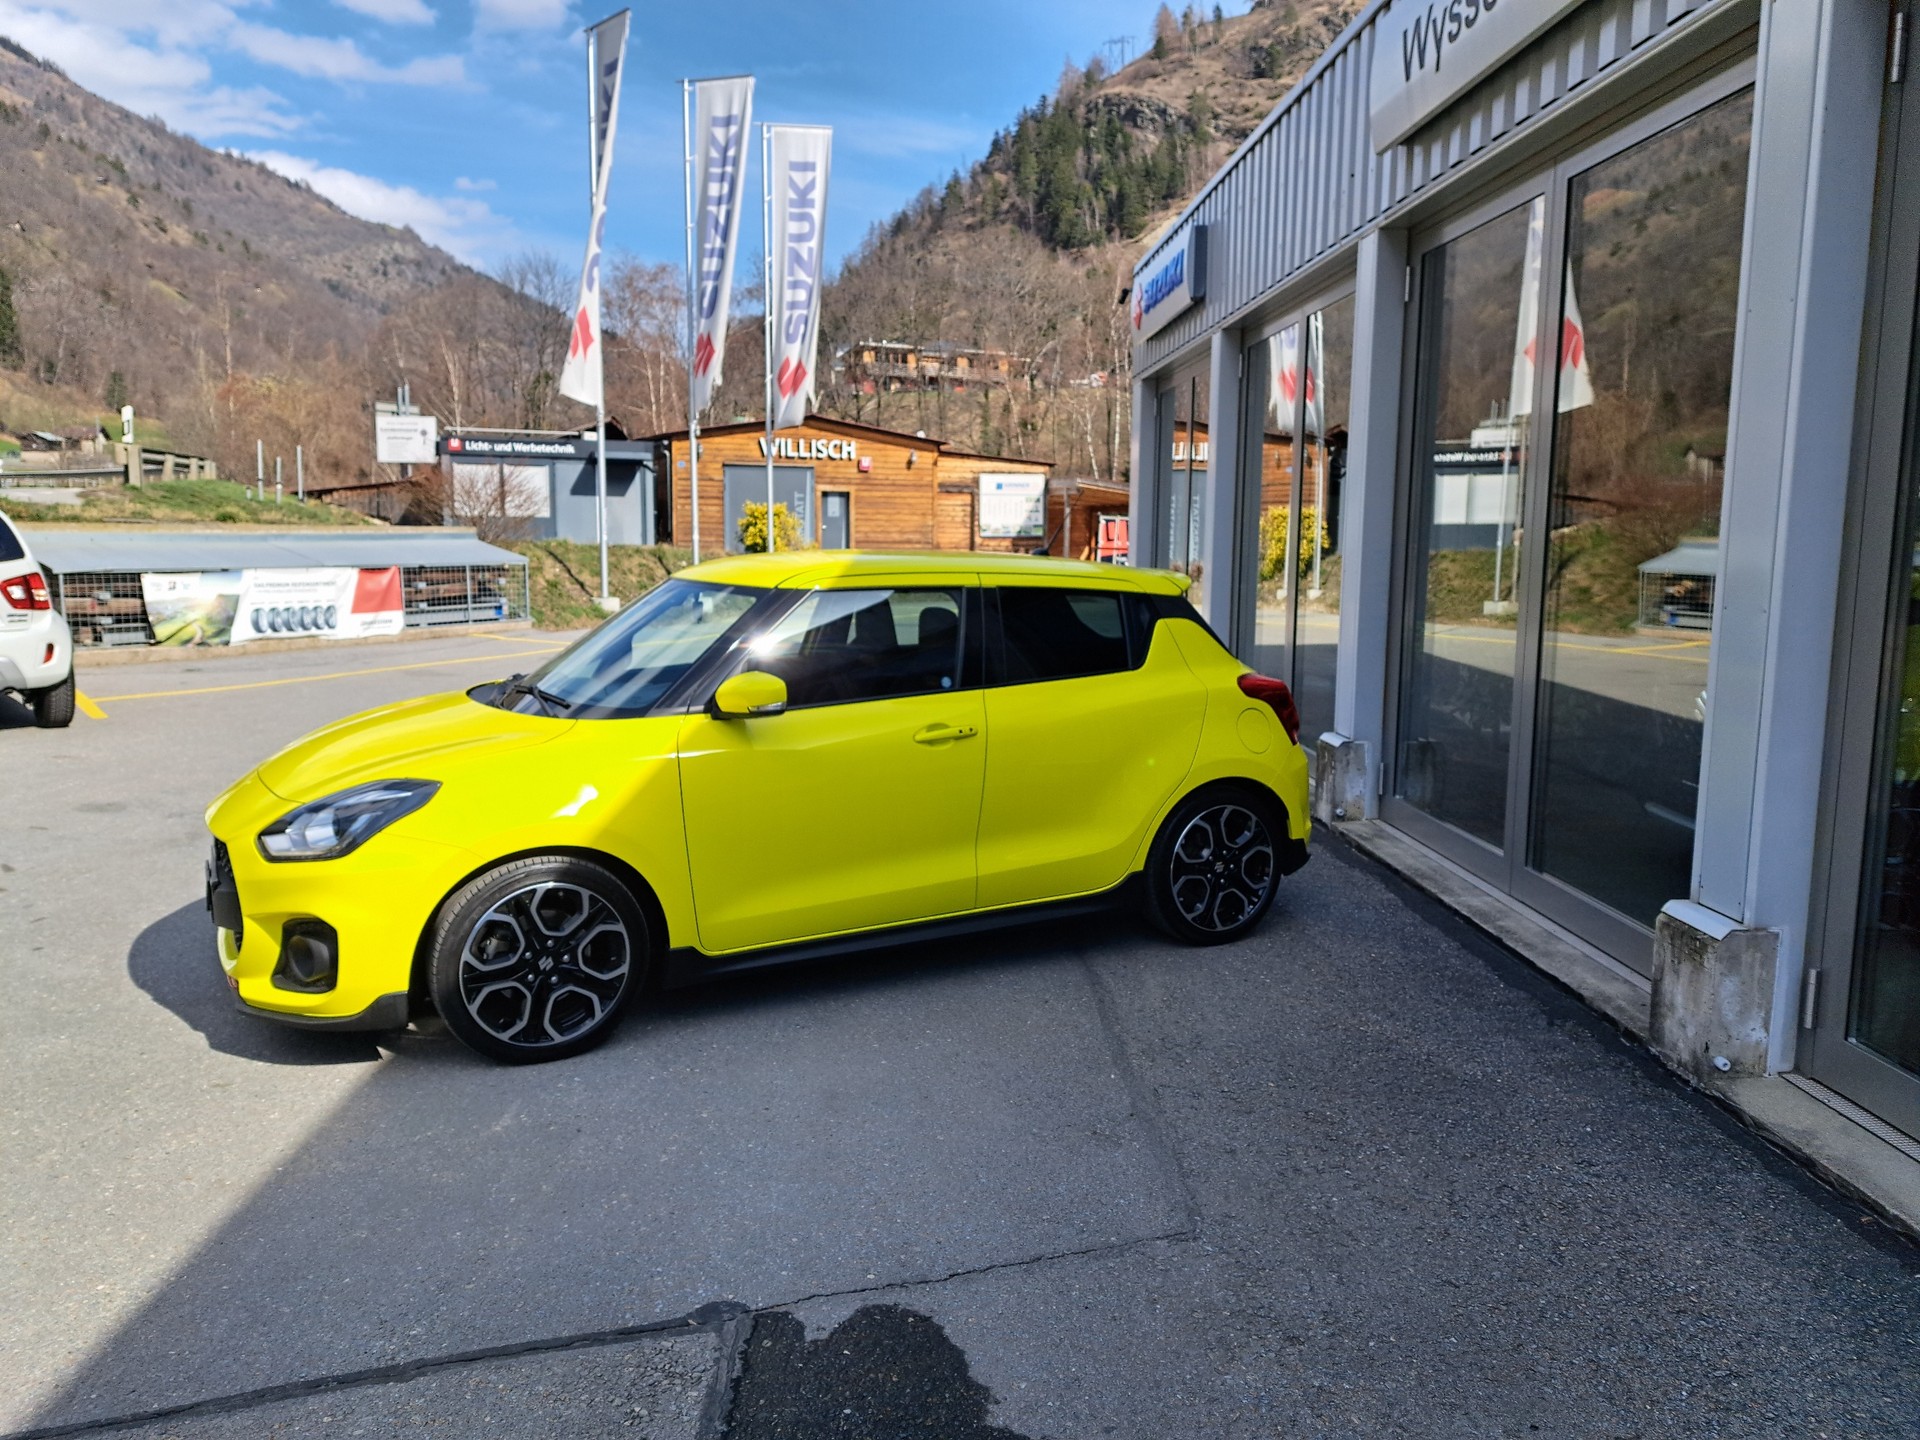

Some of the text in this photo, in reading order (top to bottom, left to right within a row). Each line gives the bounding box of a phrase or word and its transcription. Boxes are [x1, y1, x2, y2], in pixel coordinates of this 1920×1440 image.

[701, 114, 739, 320] SUZUKI
[784, 160, 817, 346] SUZUKI
[465, 440, 576, 454] Licht- und Werbetechnik
[759, 436, 856, 460] WILLISCH
